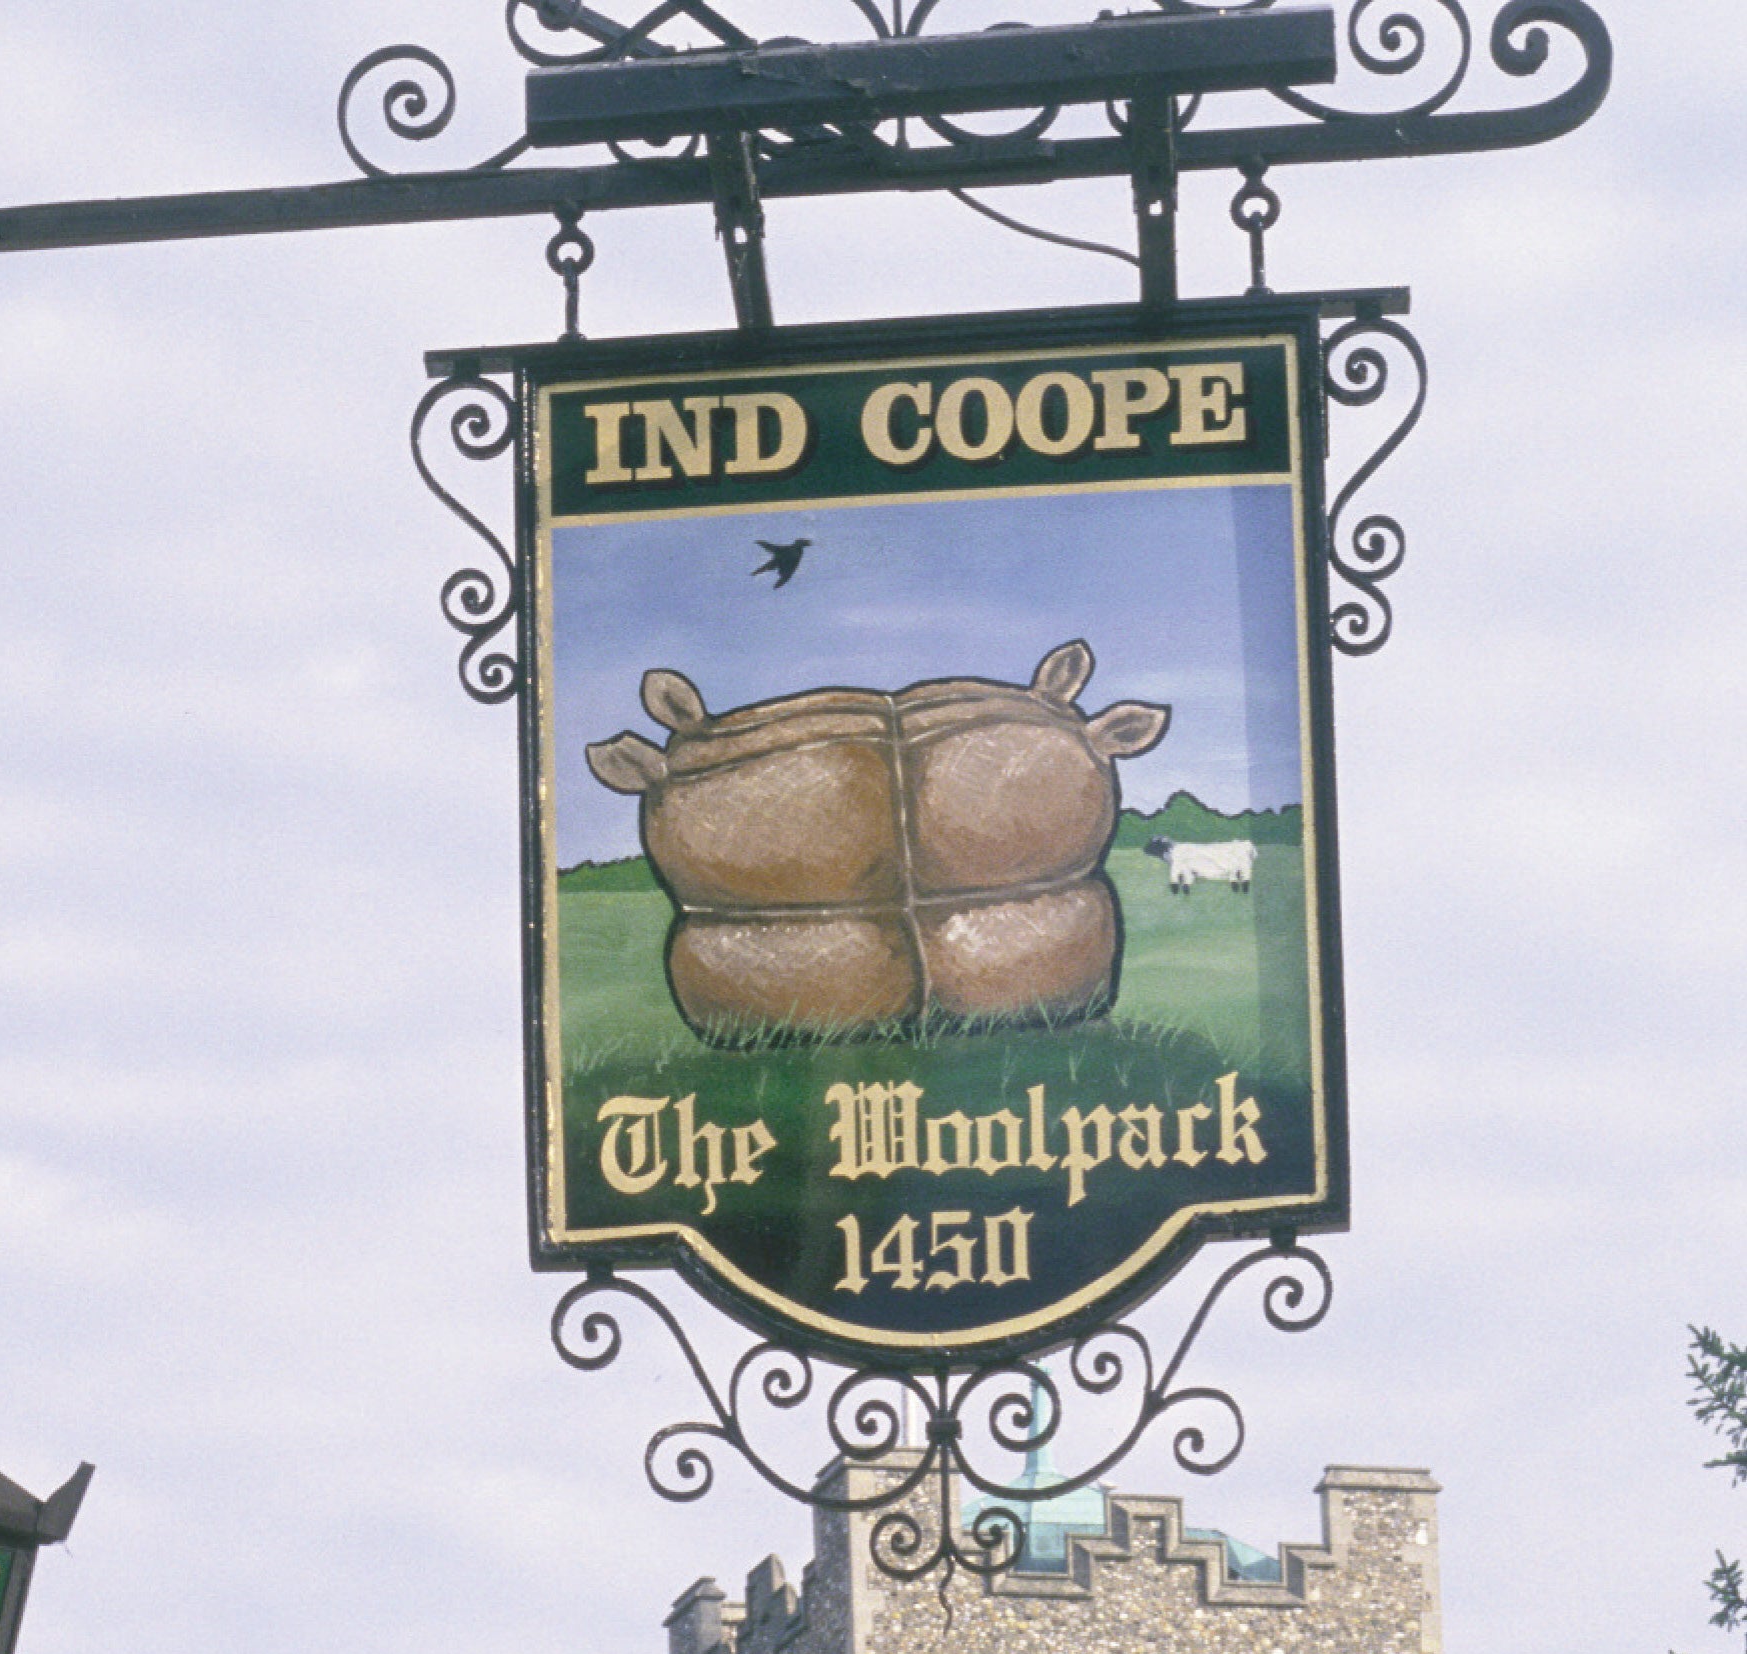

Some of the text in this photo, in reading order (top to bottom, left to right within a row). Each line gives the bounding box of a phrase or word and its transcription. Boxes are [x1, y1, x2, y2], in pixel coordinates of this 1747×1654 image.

[584, 362, 1244, 488] IND COOPE
[597, 1071, 1267, 1213] The Woolpack
[834, 1206, 1033, 1295] 1450
